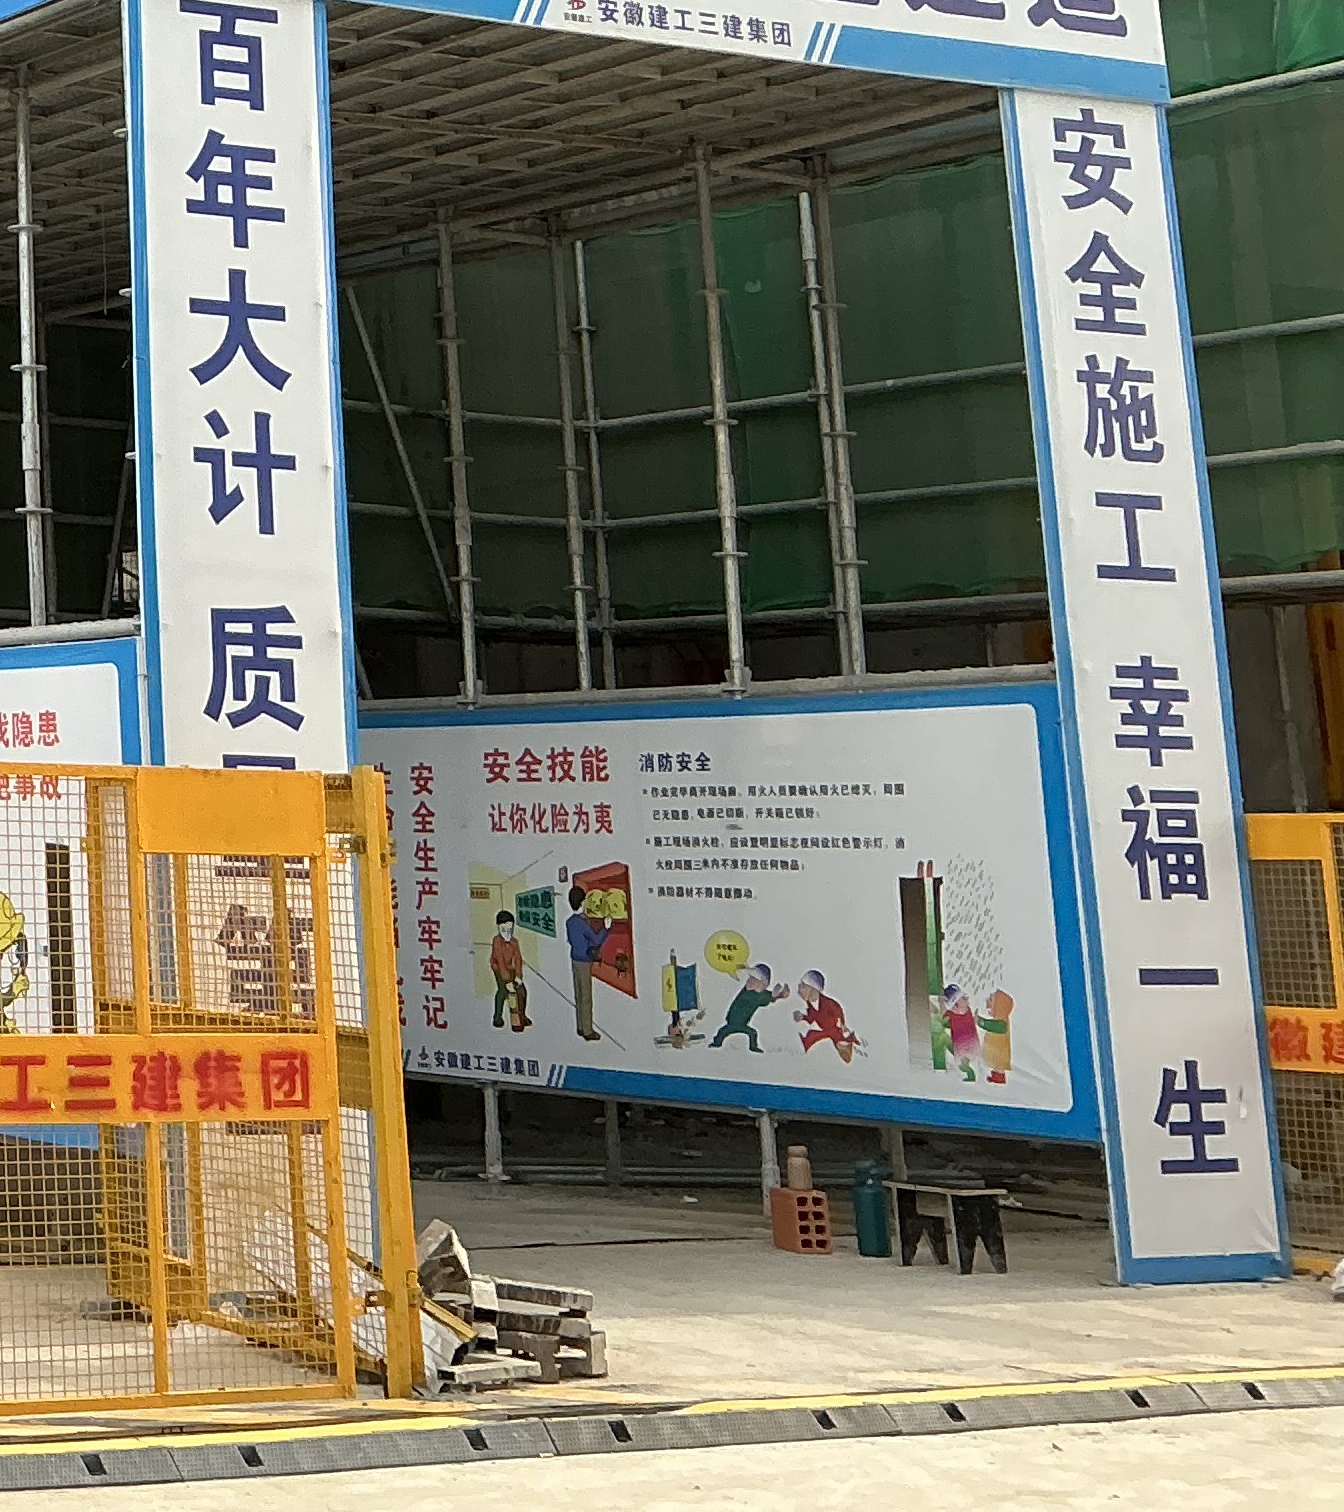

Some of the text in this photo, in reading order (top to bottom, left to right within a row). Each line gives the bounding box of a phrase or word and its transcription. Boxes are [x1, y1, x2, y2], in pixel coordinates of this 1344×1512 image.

[1053, 108, 1240, 1175] 安全施工 幸福一生
[483, 745, 611, 784] 安全技能
[638, 751, 712, 773] 消防安全
[489, 802, 615, 835] 让你化险为夷
[410, 762, 448, 1029] 安全生产牢牢记
[433, 1049, 541, 1078] 安徽建工三建集团
